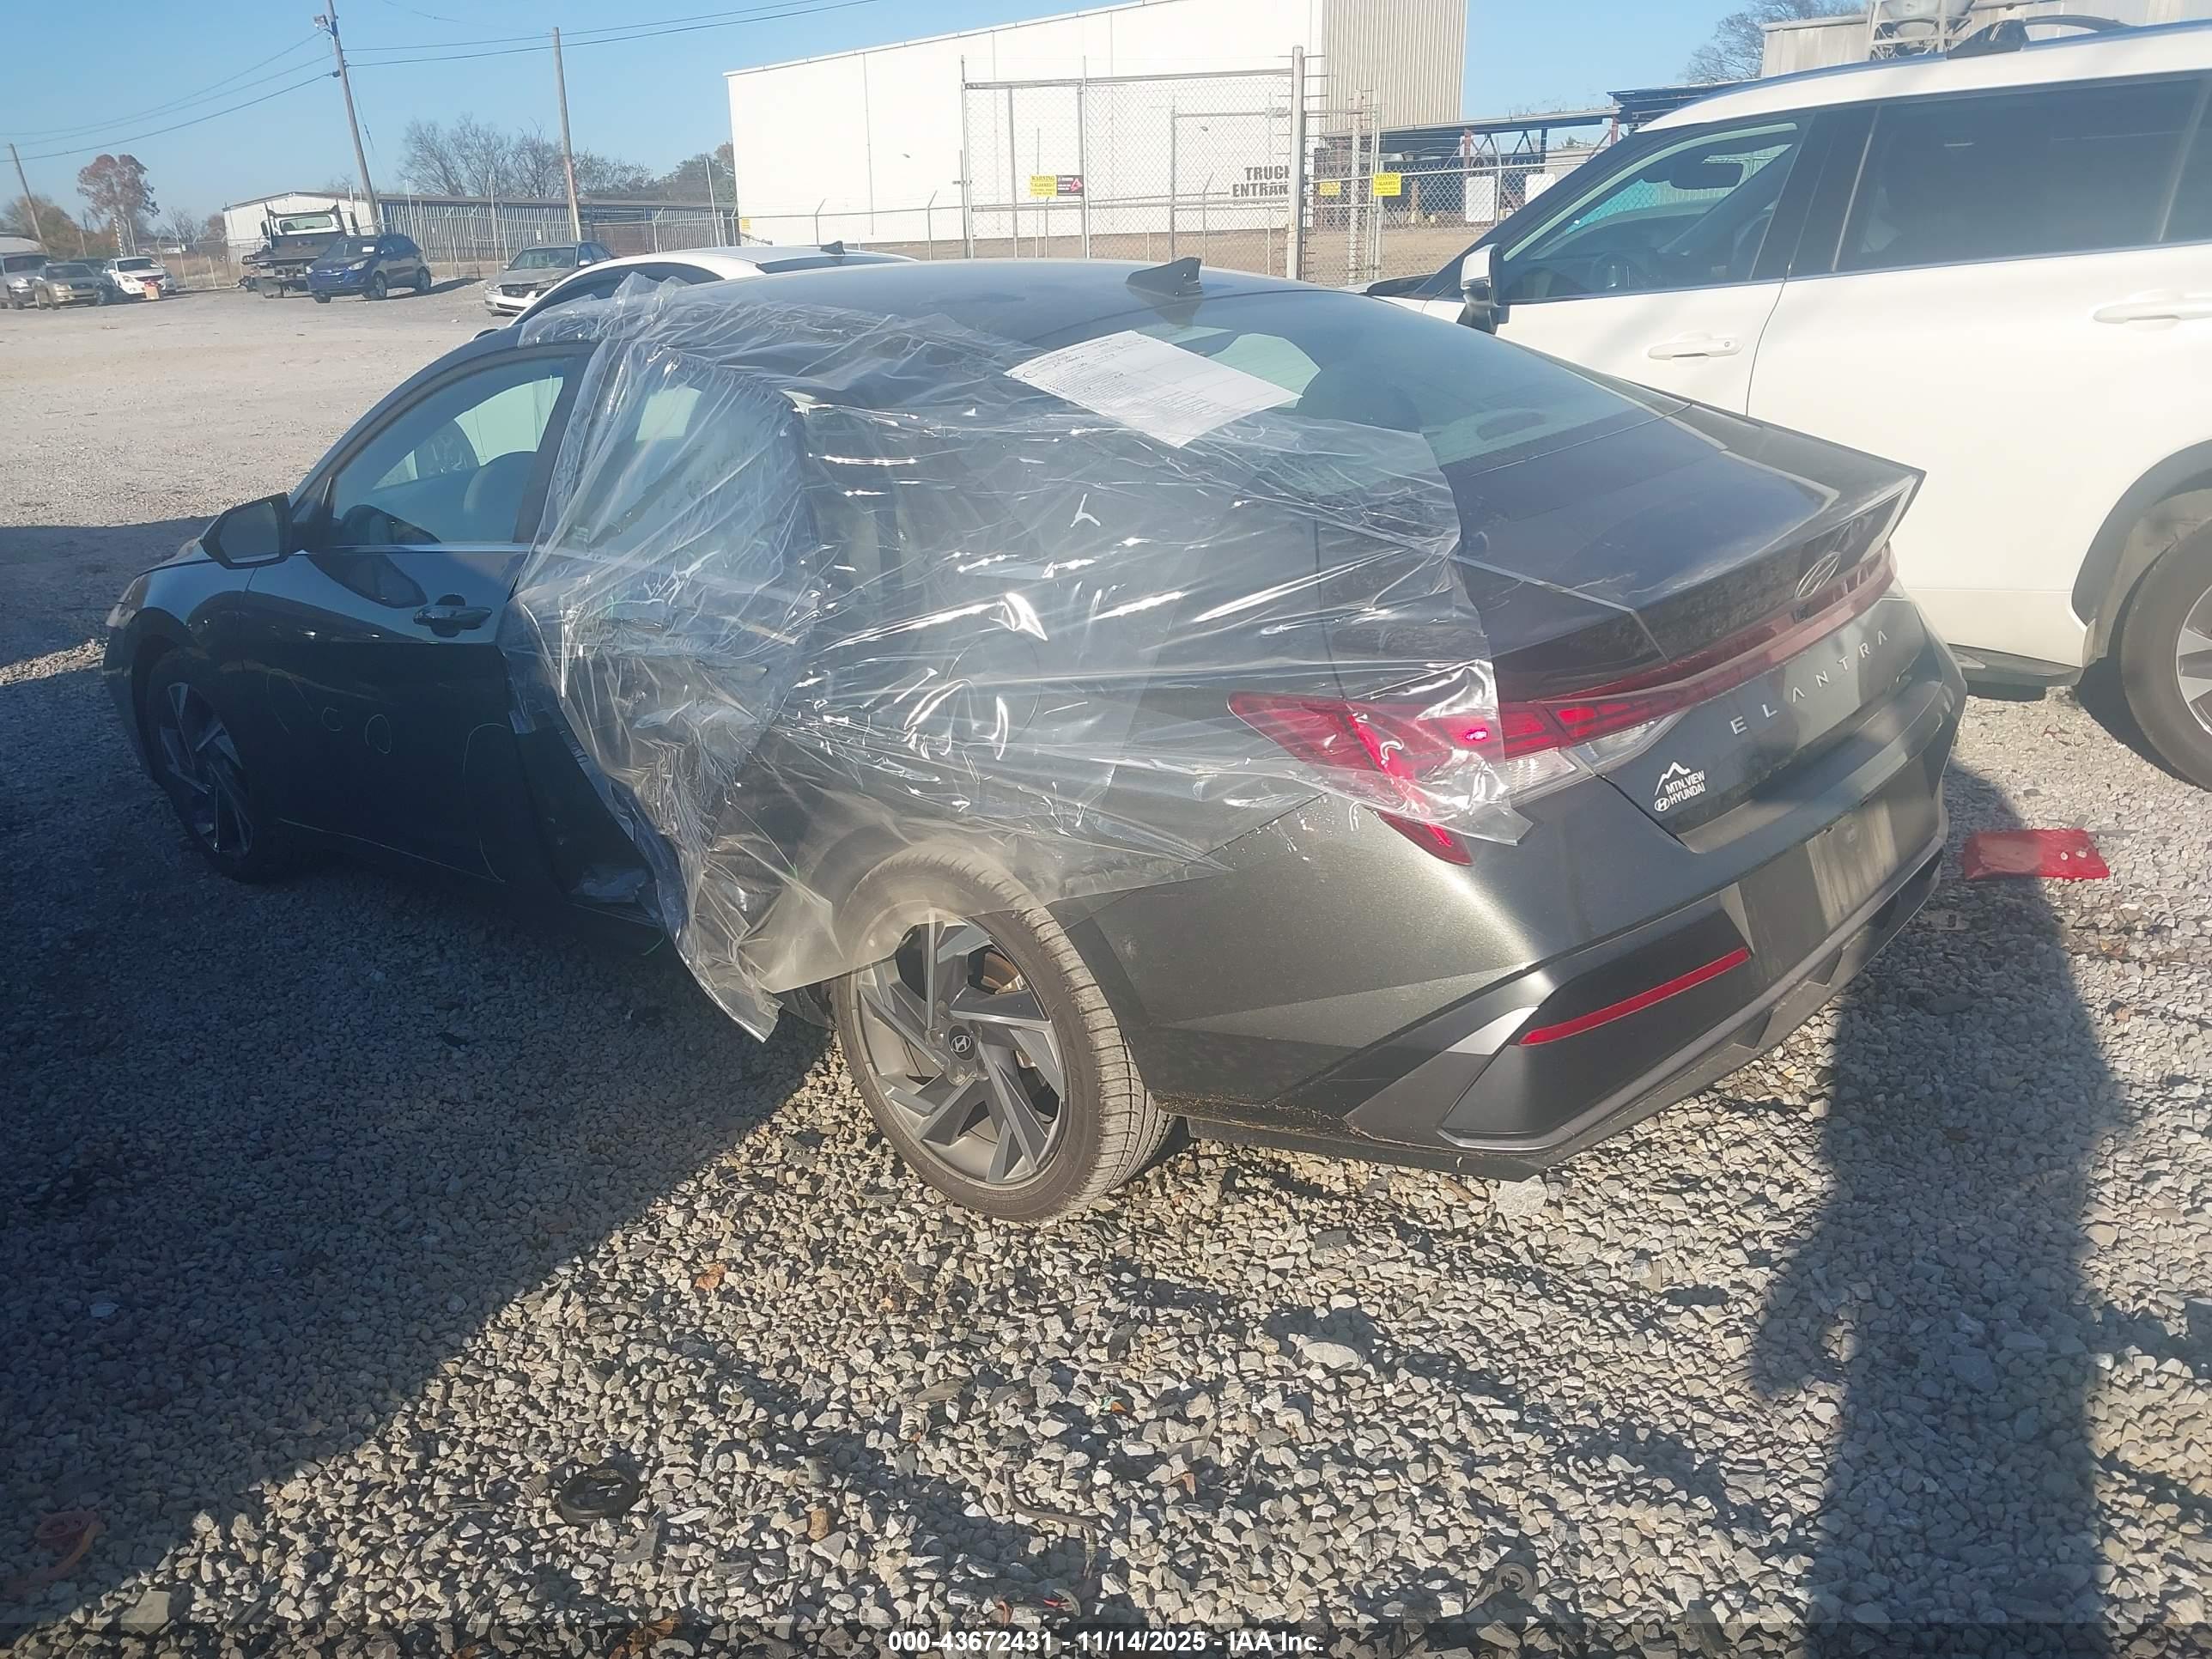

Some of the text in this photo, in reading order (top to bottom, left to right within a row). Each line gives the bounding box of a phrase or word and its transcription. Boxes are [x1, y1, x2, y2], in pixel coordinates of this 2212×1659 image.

[1232, 179, 1289, 197] ENTRAN
[1730, 629, 1888, 735] ELANTRA
[1668, 781, 1706, 805] HYUNDAI
